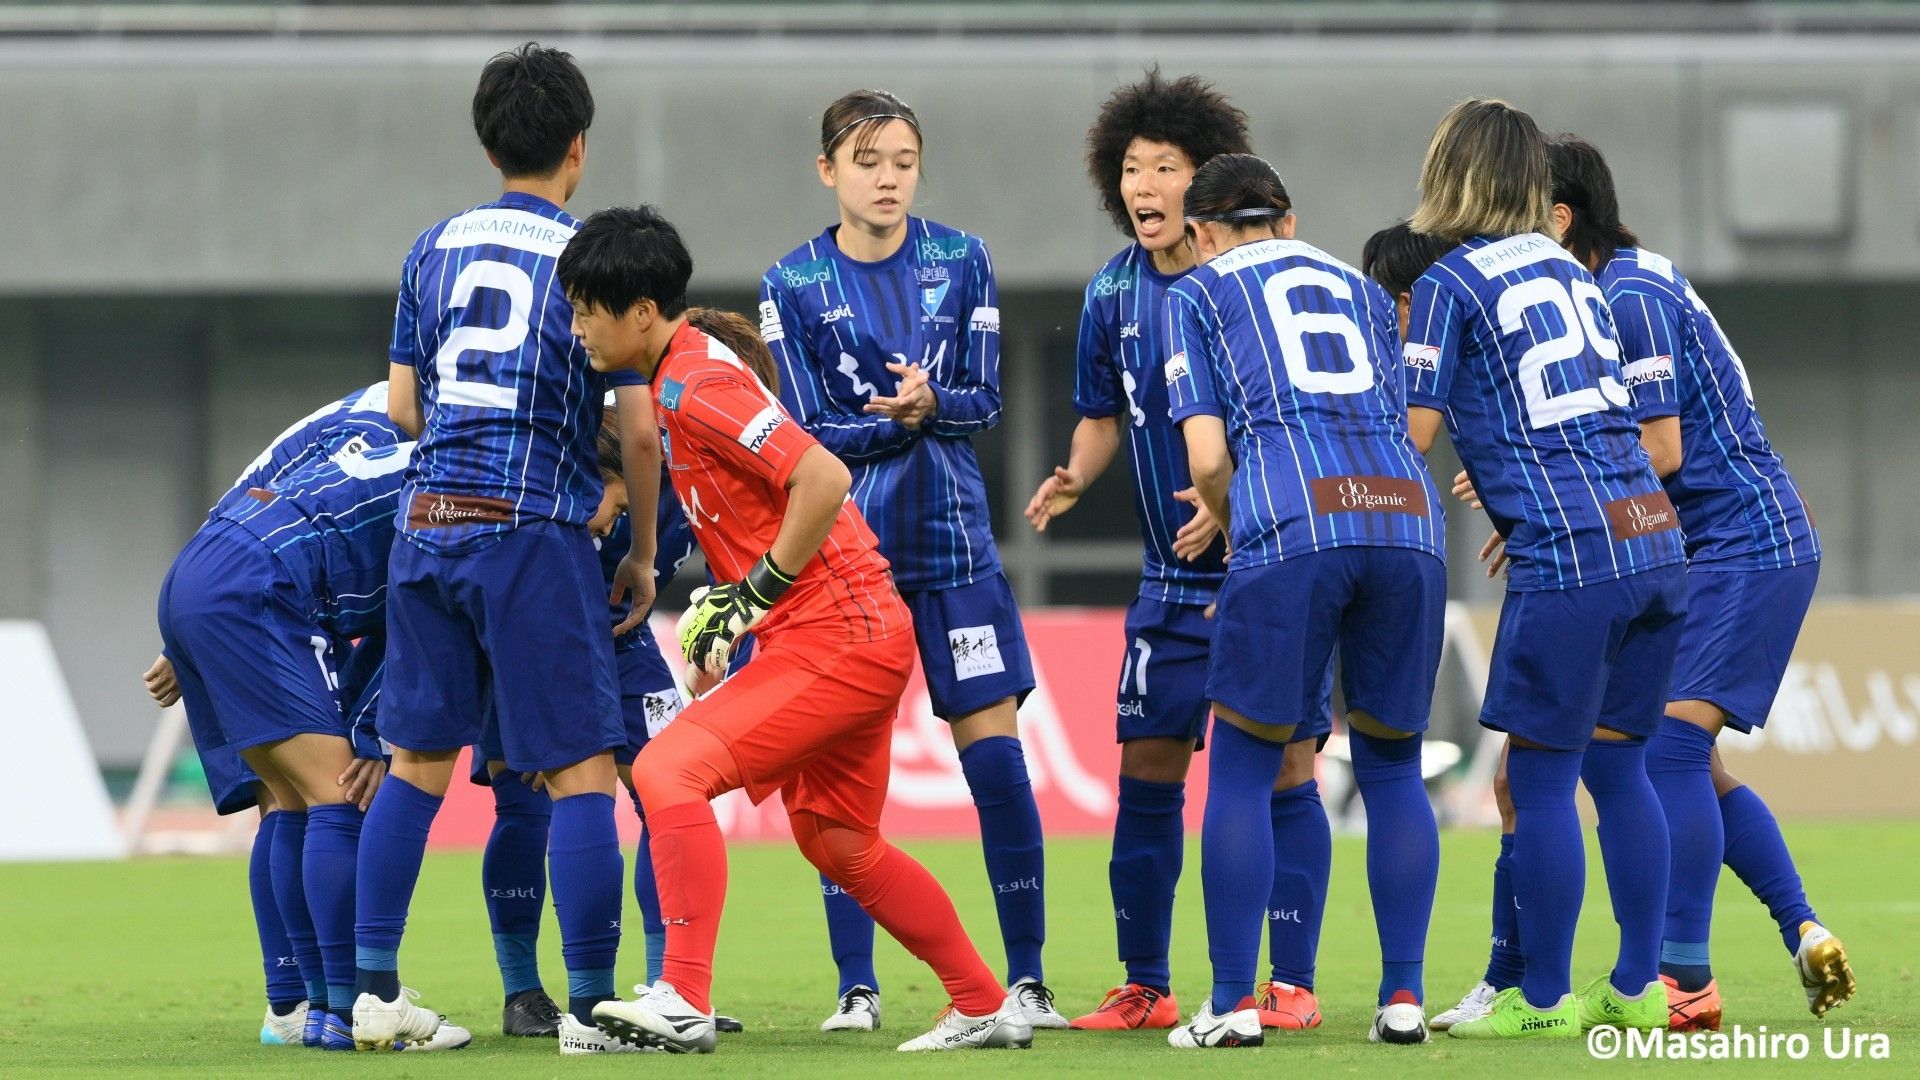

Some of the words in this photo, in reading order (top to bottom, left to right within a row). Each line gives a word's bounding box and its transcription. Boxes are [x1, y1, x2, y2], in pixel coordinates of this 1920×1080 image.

[436, 260, 534, 410] 2
[1263, 266, 1375, 394] 6
[1496, 276, 1632, 430] 29
[563, 1041, 607, 1054] ATHLETA
[944, 1016, 998, 1046] PENALTY
[1520, 1018, 1568, 1032] ATHLETA
